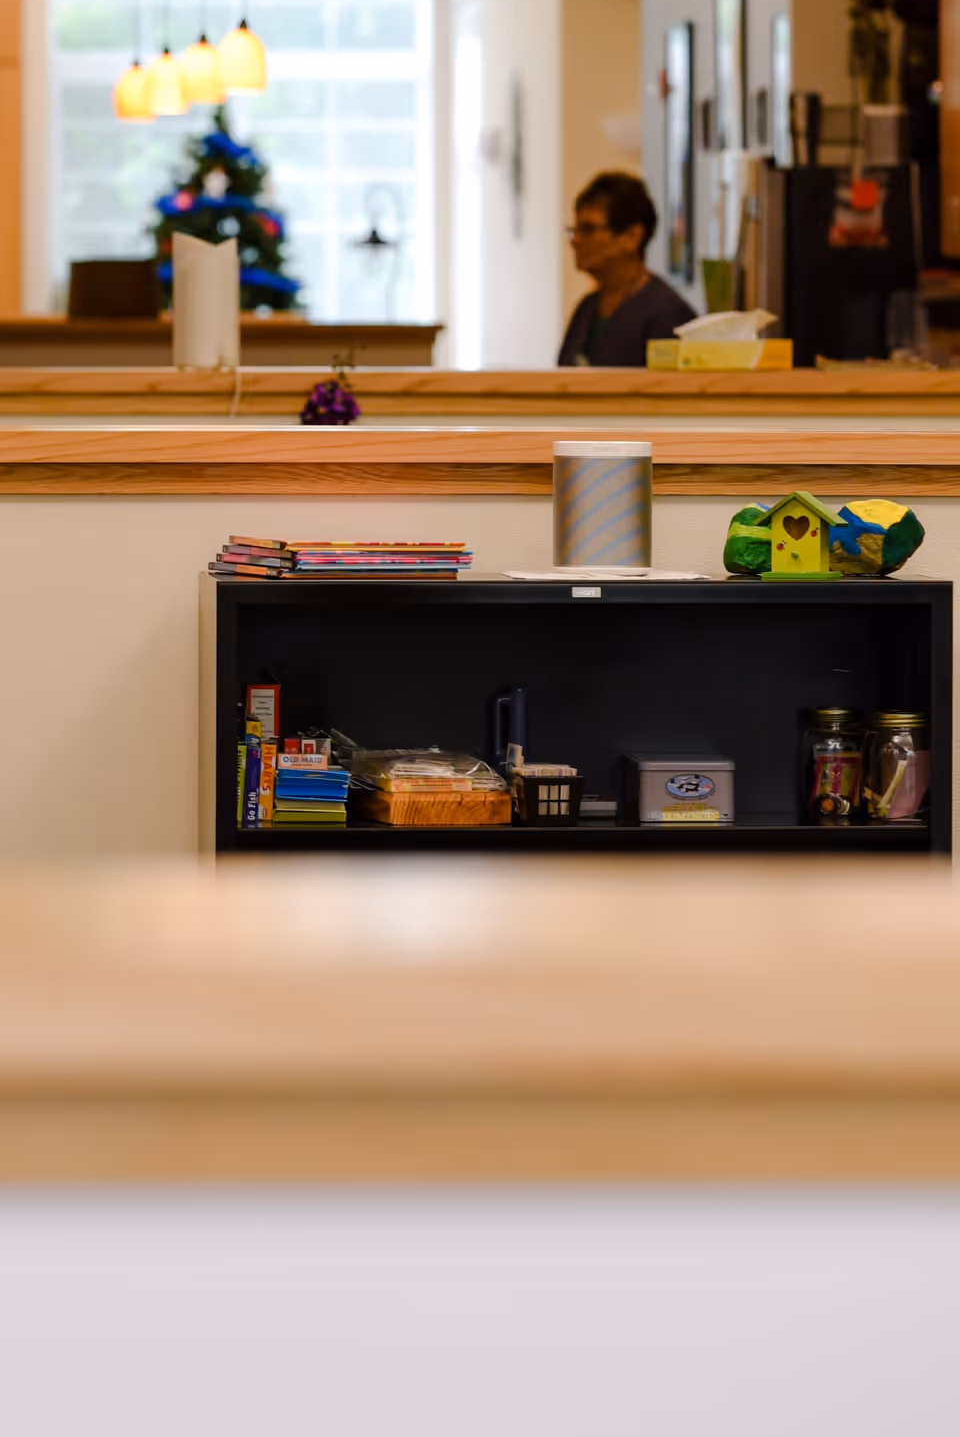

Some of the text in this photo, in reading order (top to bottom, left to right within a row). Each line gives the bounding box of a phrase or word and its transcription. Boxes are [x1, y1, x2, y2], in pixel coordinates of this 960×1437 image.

[262, 746, 274, 791] HEARTS
[248, 791, 257, 808] Fish
[248, 808, 256, 820] Go
